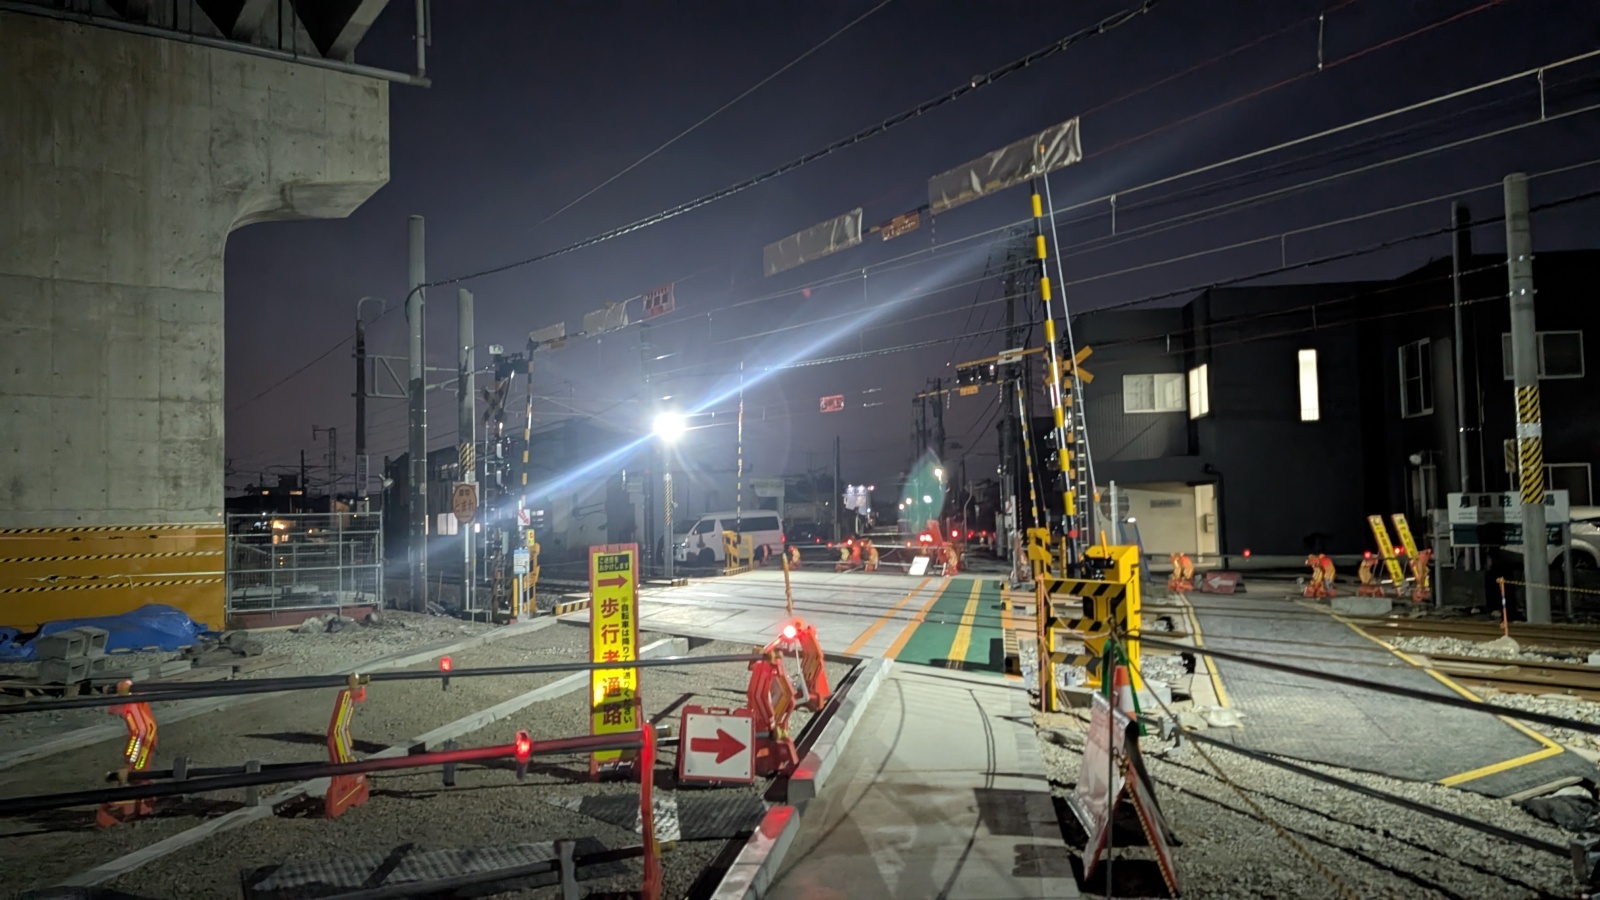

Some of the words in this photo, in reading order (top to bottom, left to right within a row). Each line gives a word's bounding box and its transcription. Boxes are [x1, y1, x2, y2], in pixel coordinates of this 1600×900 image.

[601, 597, 621, 725] 歩行者通路
